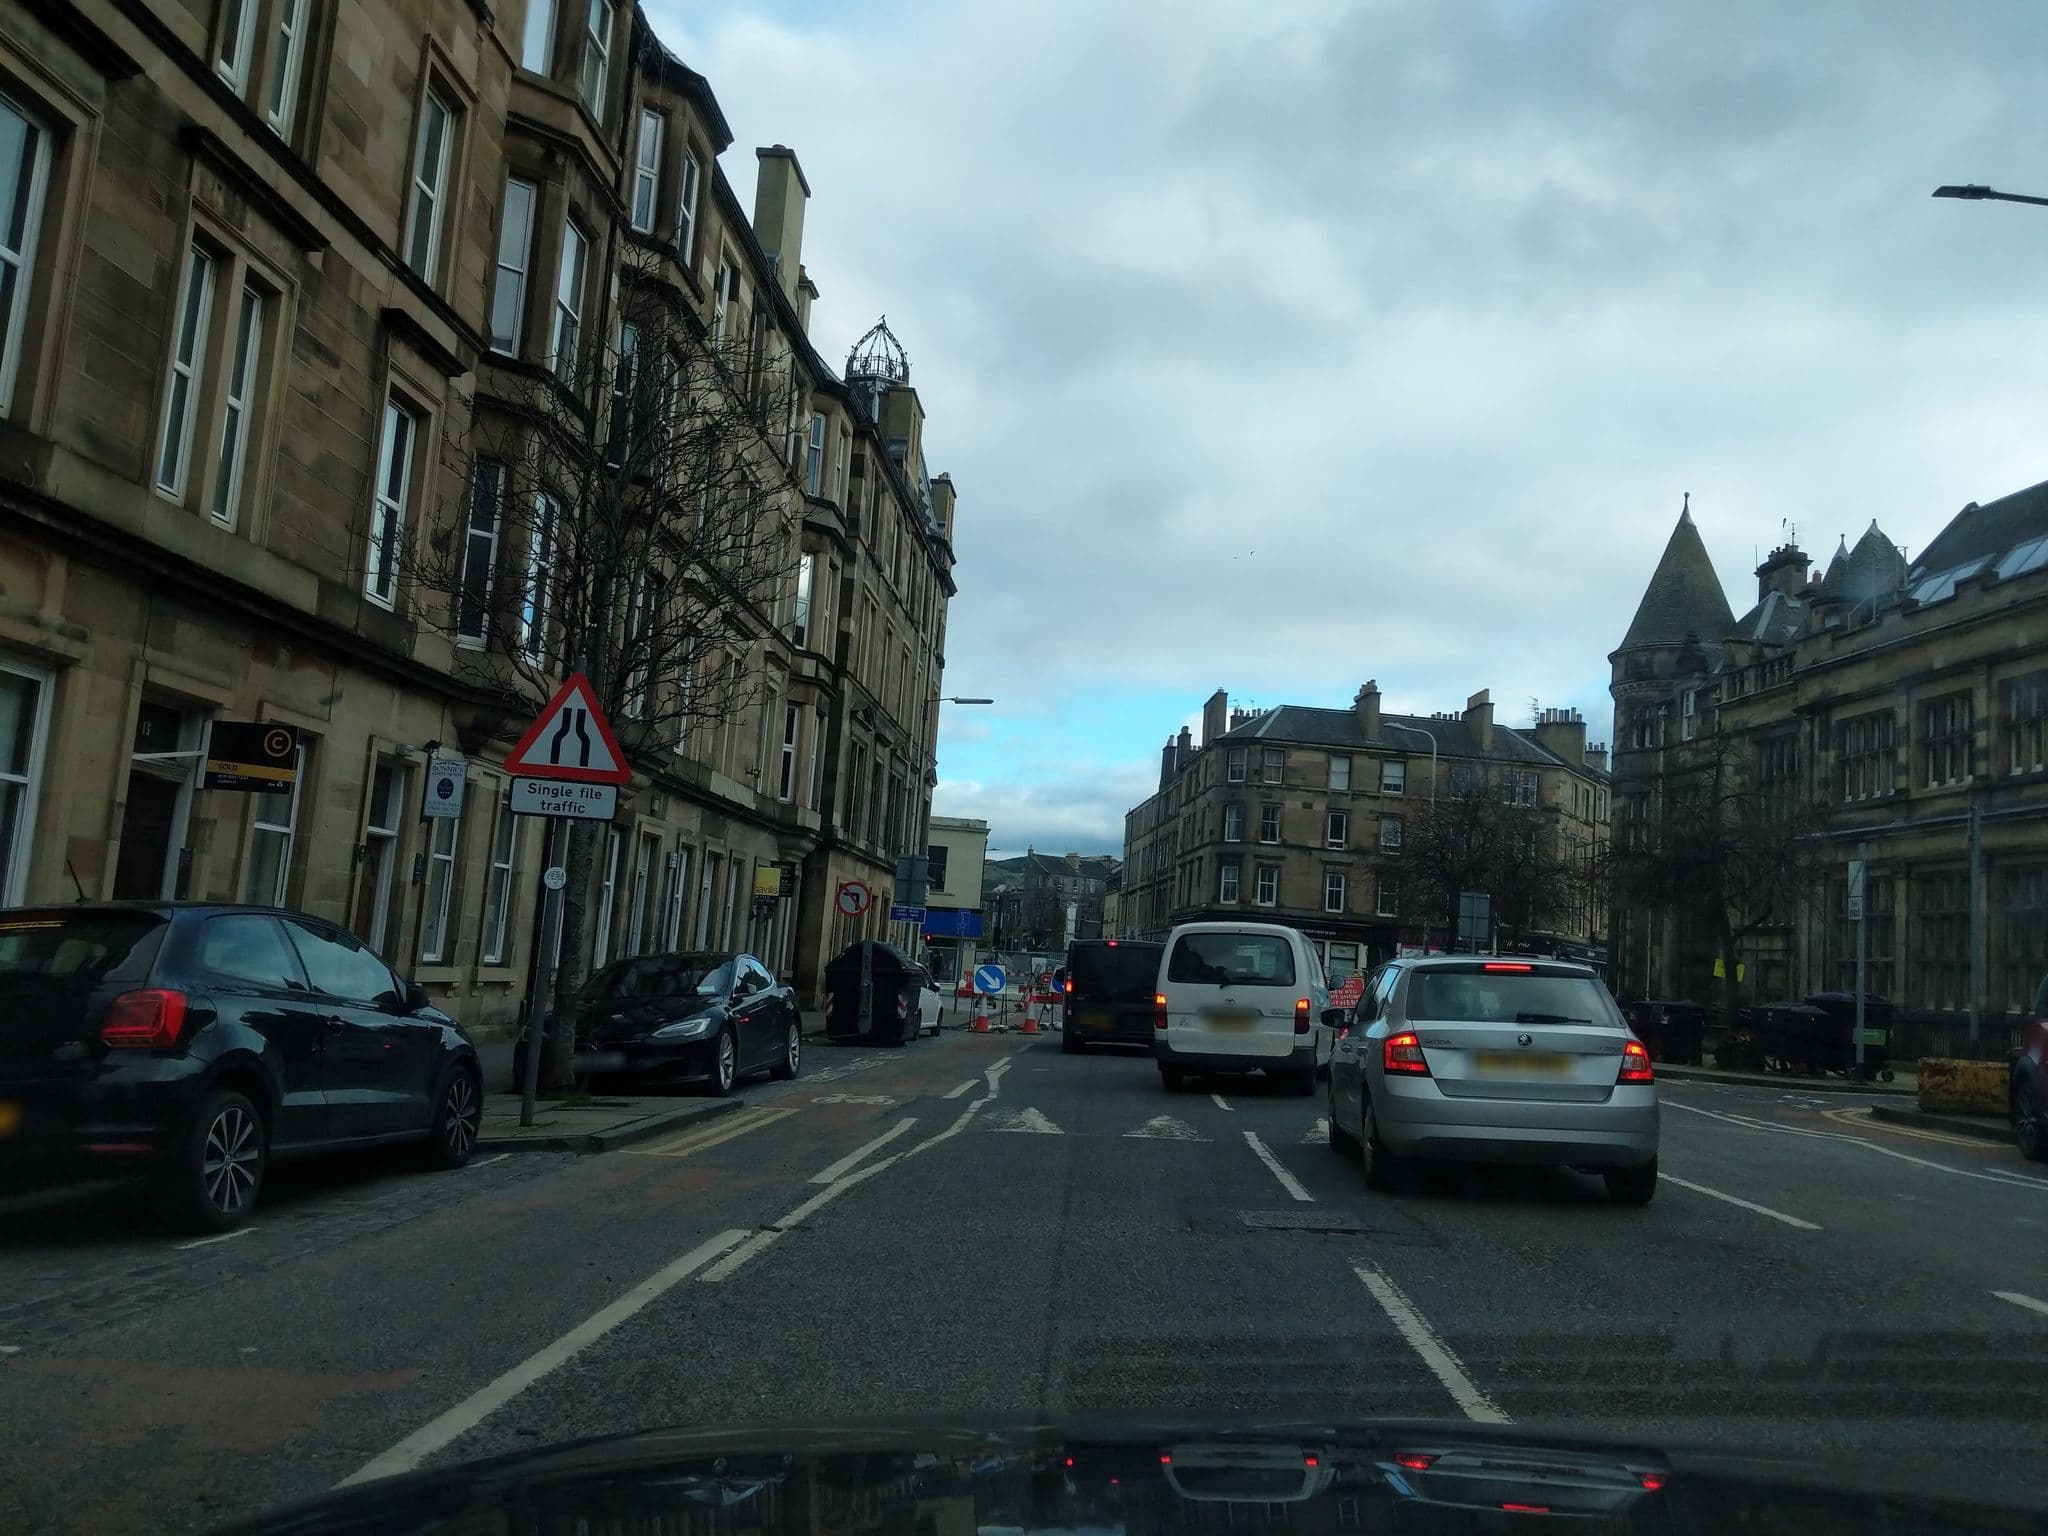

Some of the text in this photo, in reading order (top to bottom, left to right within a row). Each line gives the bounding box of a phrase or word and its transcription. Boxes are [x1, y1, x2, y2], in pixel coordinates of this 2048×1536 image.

[218, 762, 238, 771] SOLD
[527, 782, 603, 800] Single file
[541, 799, 586, 814] traffic
